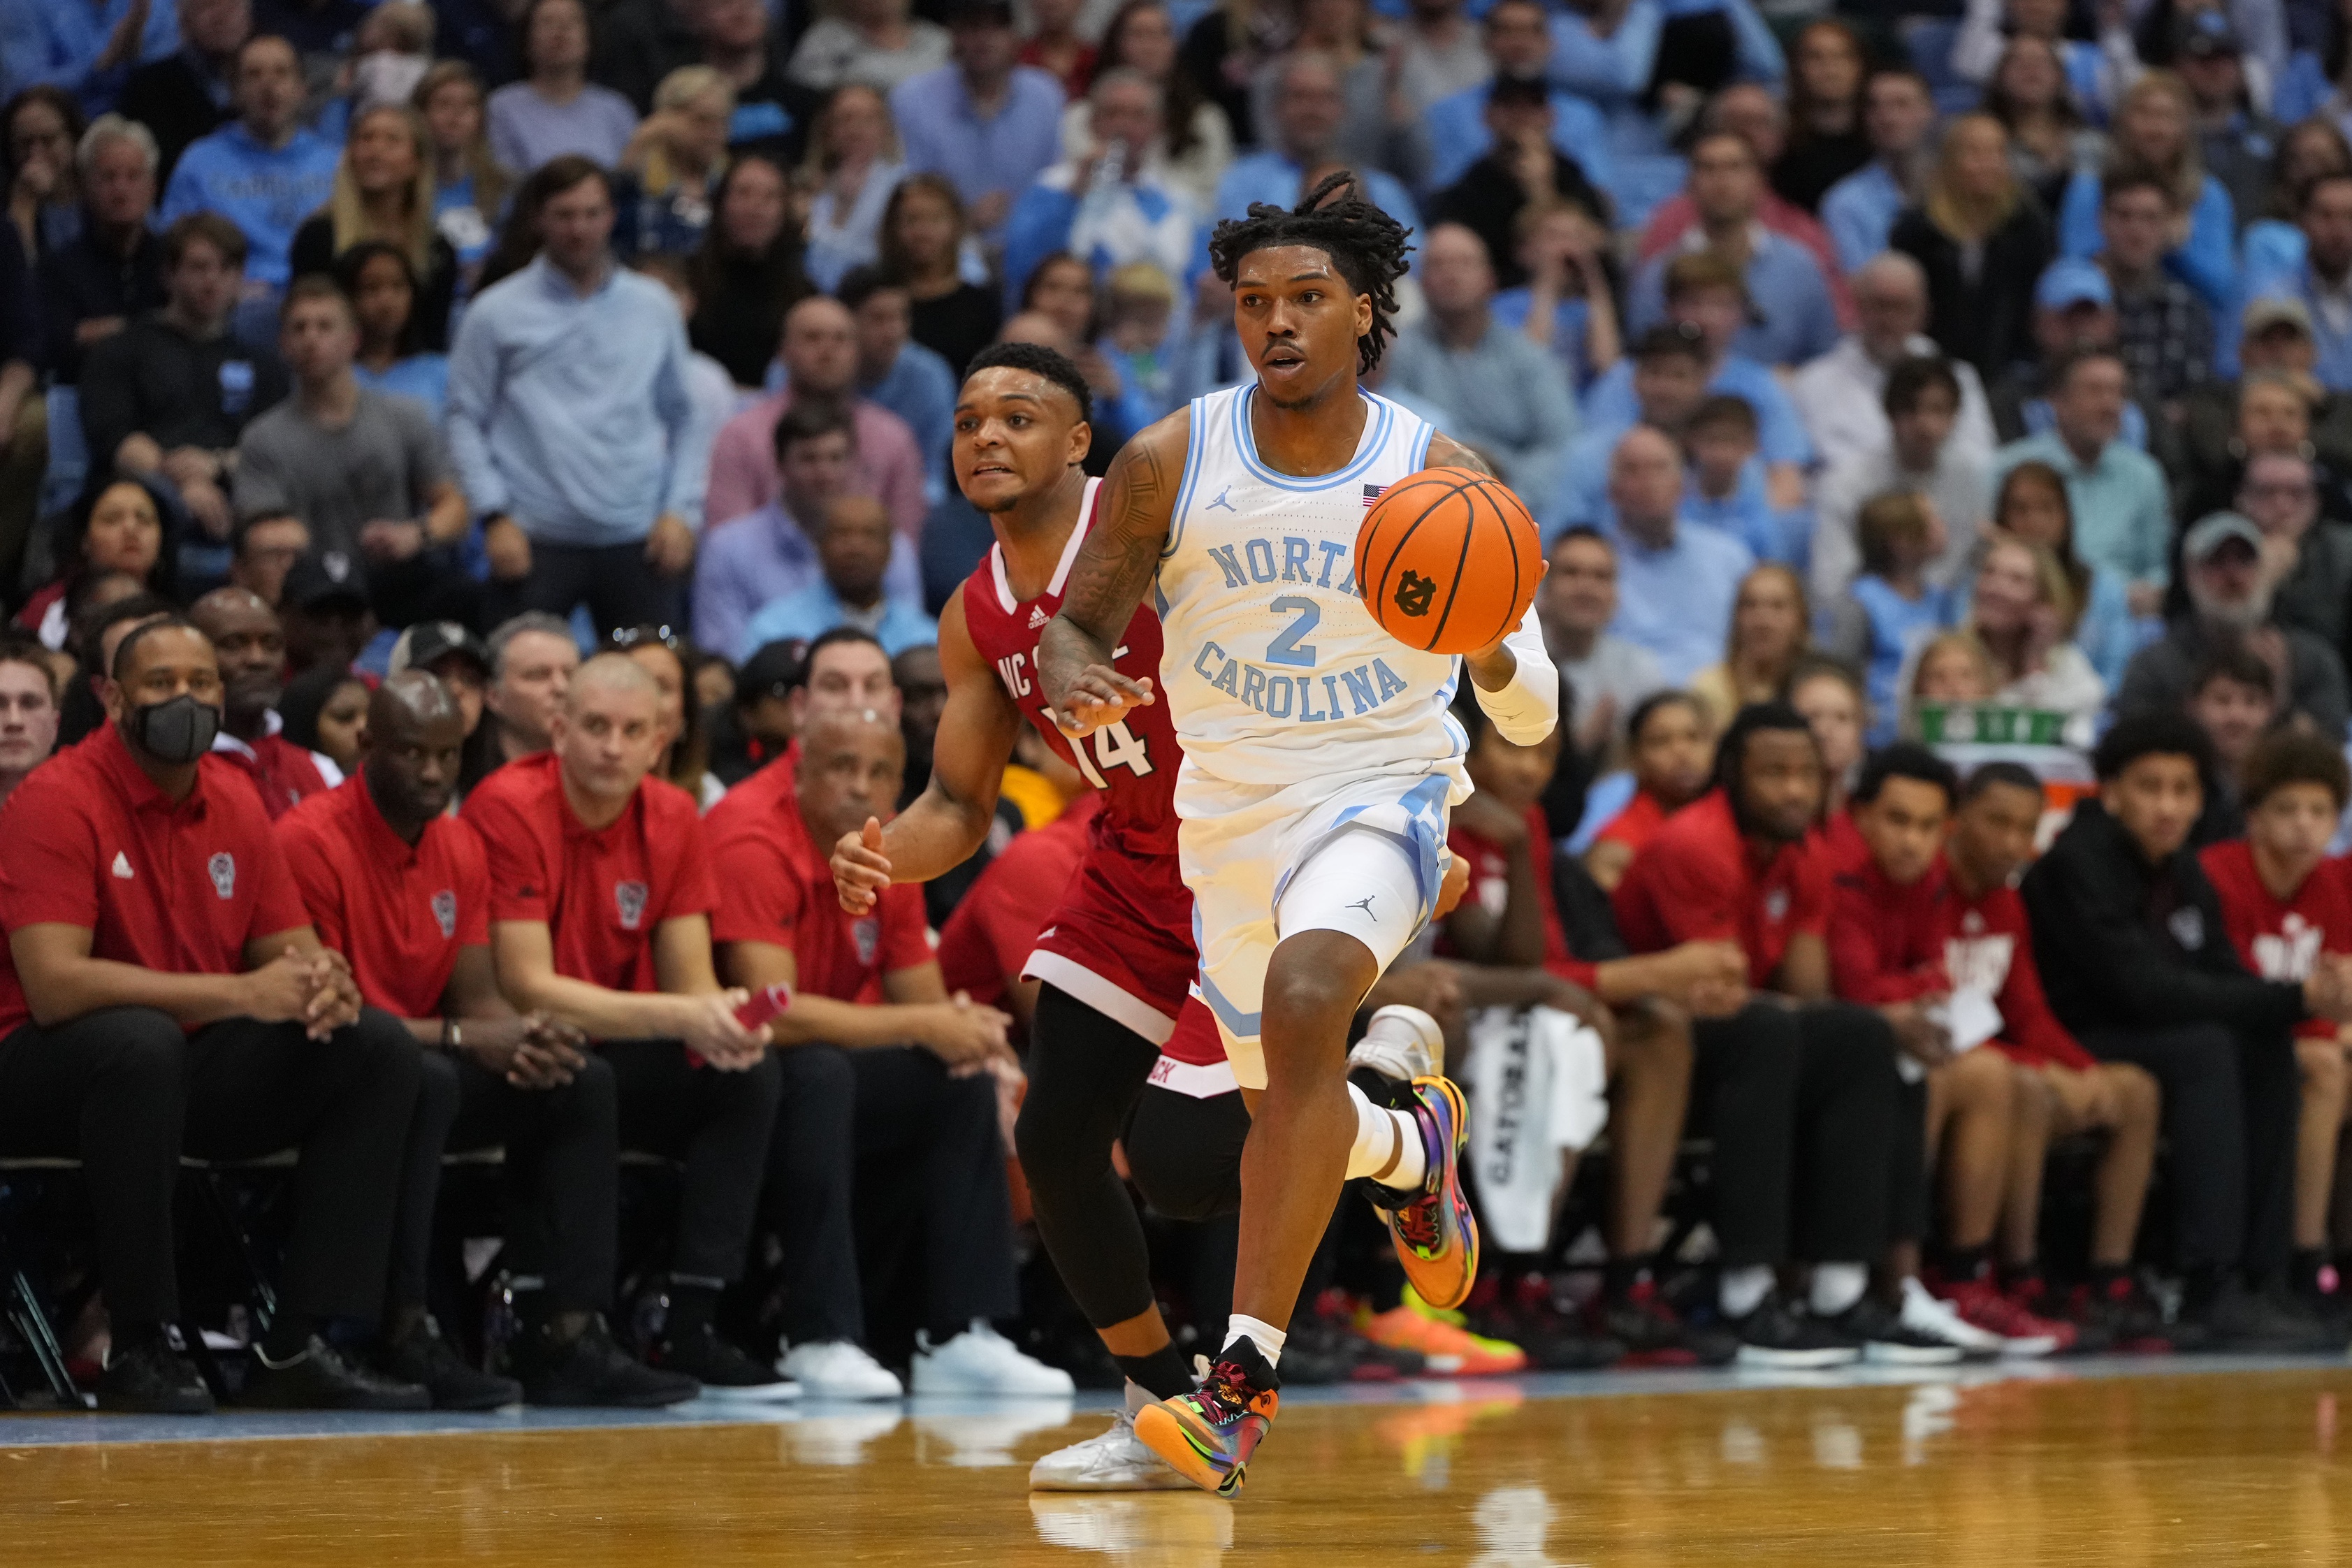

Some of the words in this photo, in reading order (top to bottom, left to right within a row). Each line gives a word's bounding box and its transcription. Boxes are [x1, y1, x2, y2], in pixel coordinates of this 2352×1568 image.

[1265, 596, 1321, 667] 2
[997, 652, 1031, 699] NC
[1194, 641, 1408, 722] CAROLINA
[1038, 706, 1155, 790] 14
